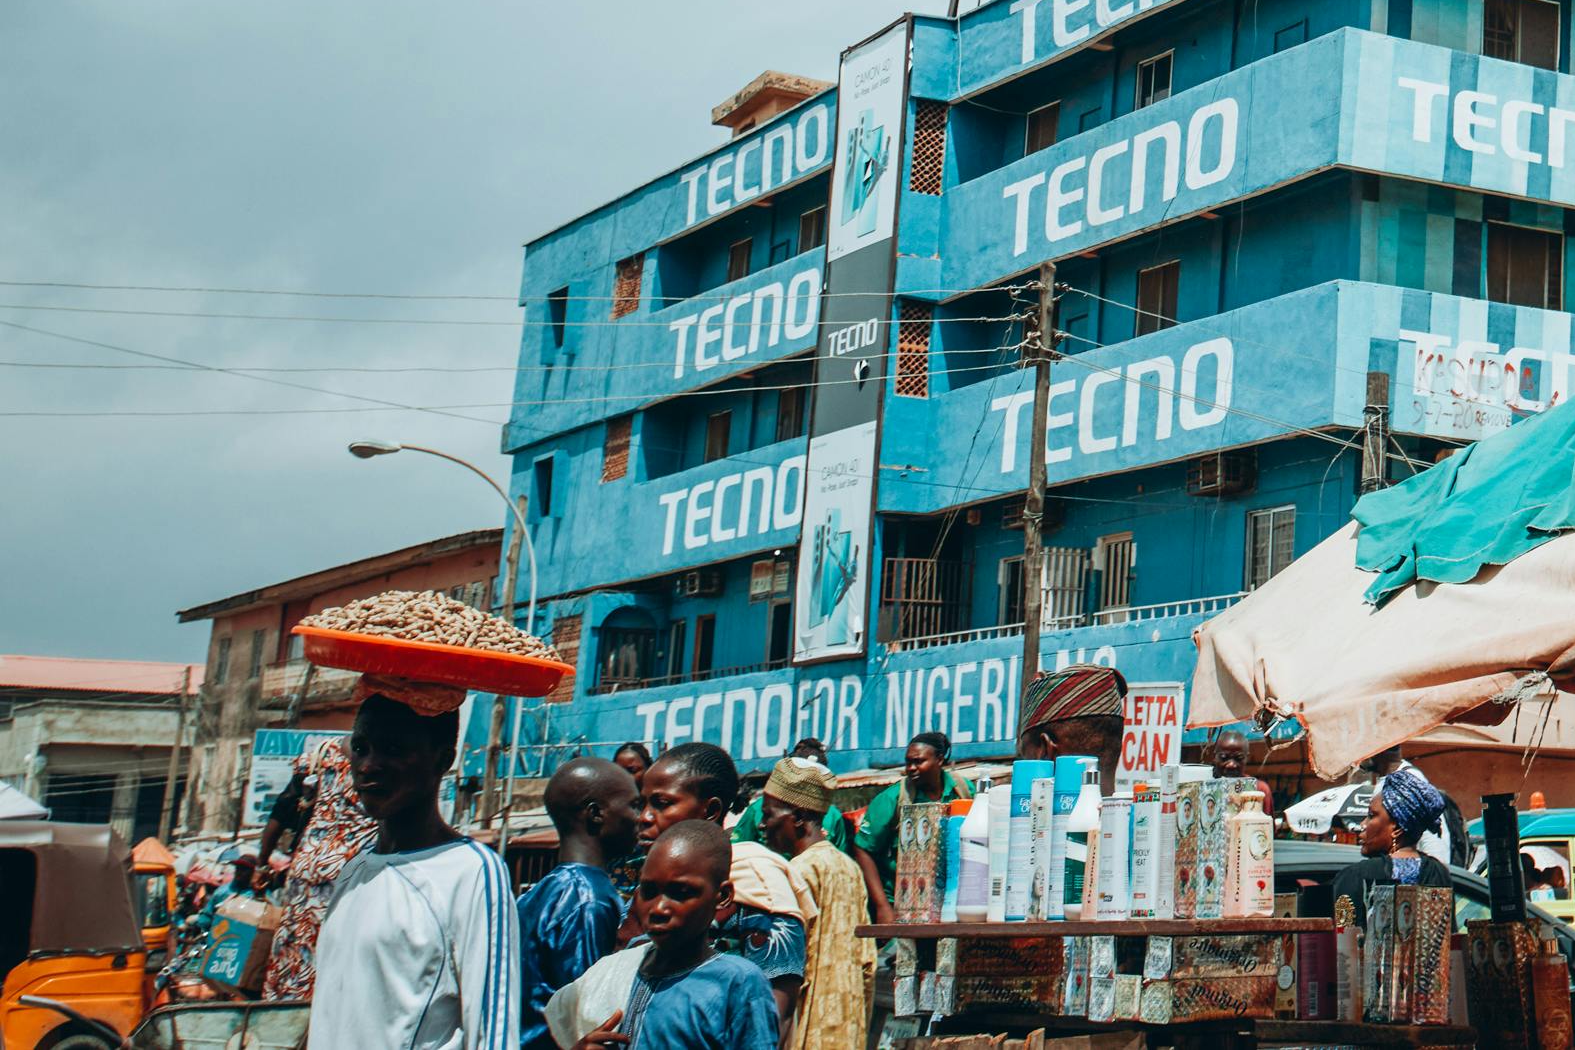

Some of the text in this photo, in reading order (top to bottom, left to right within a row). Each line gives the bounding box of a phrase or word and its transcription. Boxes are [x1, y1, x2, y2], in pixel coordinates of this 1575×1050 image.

[681, 103, 828, 226] TECNO
[1003, 97, 1239, 257] TECNO
[669, 267, 822, 380] TECNO
[827, 317, 879, 358] TECNO
[991, 336, 1234, 474] TECNO
[659, 454, 806, 555] TECNO
